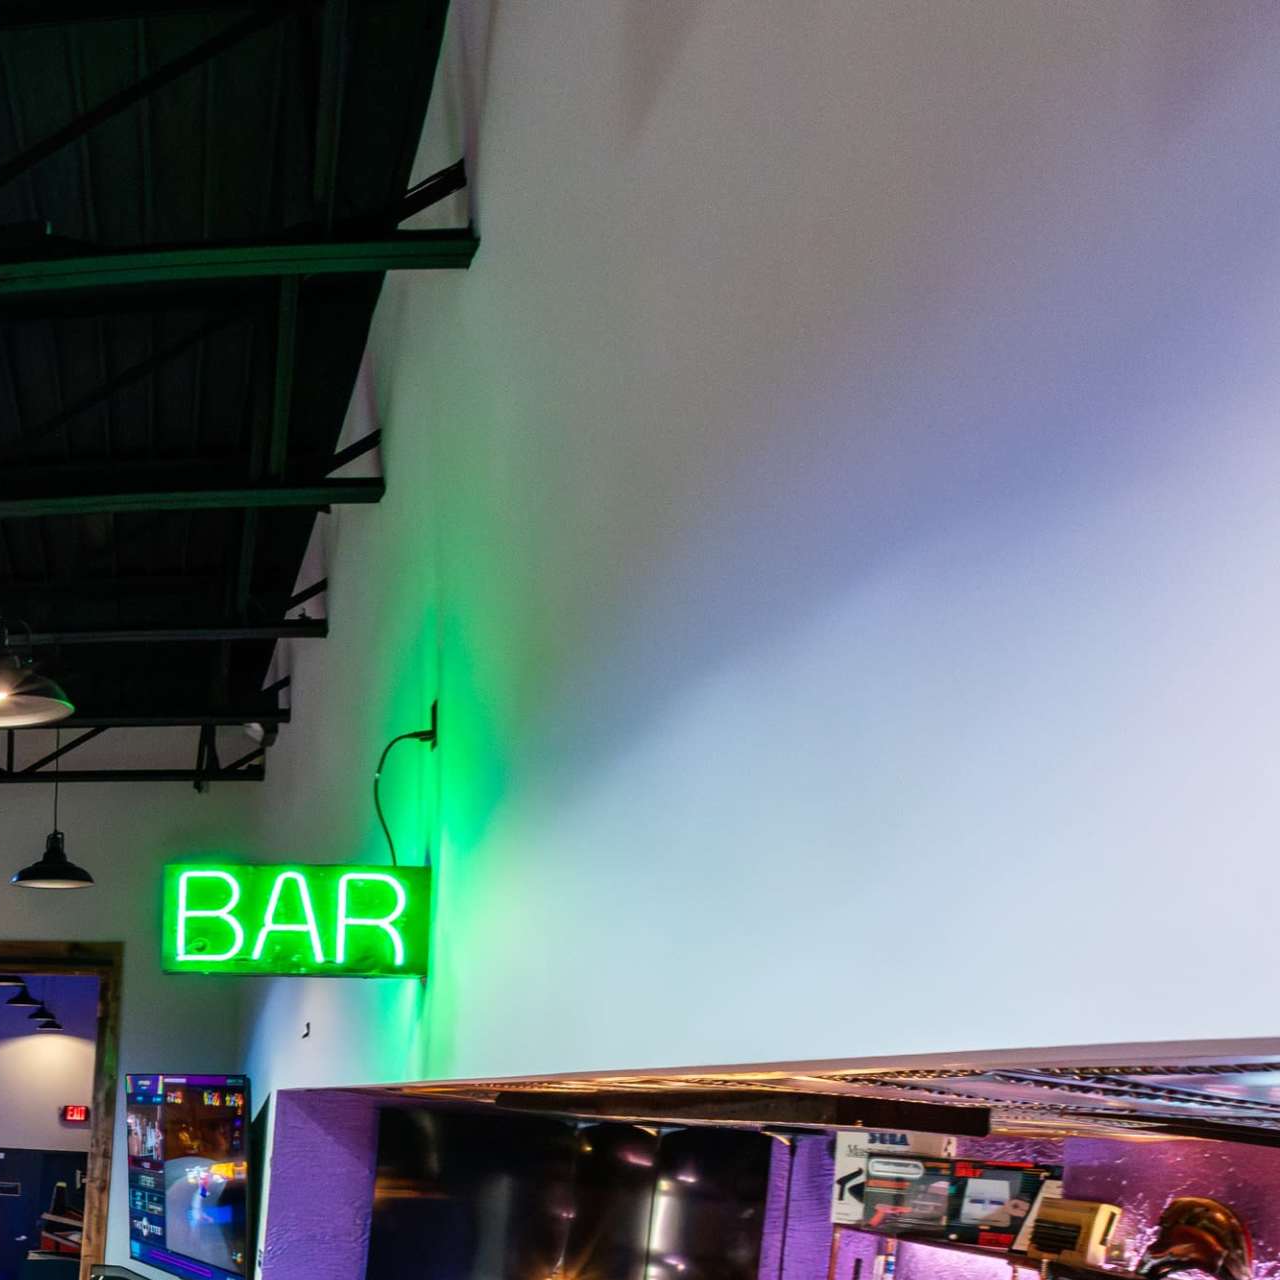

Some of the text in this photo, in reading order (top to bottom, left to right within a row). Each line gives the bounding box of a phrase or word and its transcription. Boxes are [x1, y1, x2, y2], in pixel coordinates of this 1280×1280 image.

[175, 869, 408, 966] BAR
[66, 1107, 86, 1120] EXIT
[868, 1132, 909, 1146] SEGA
